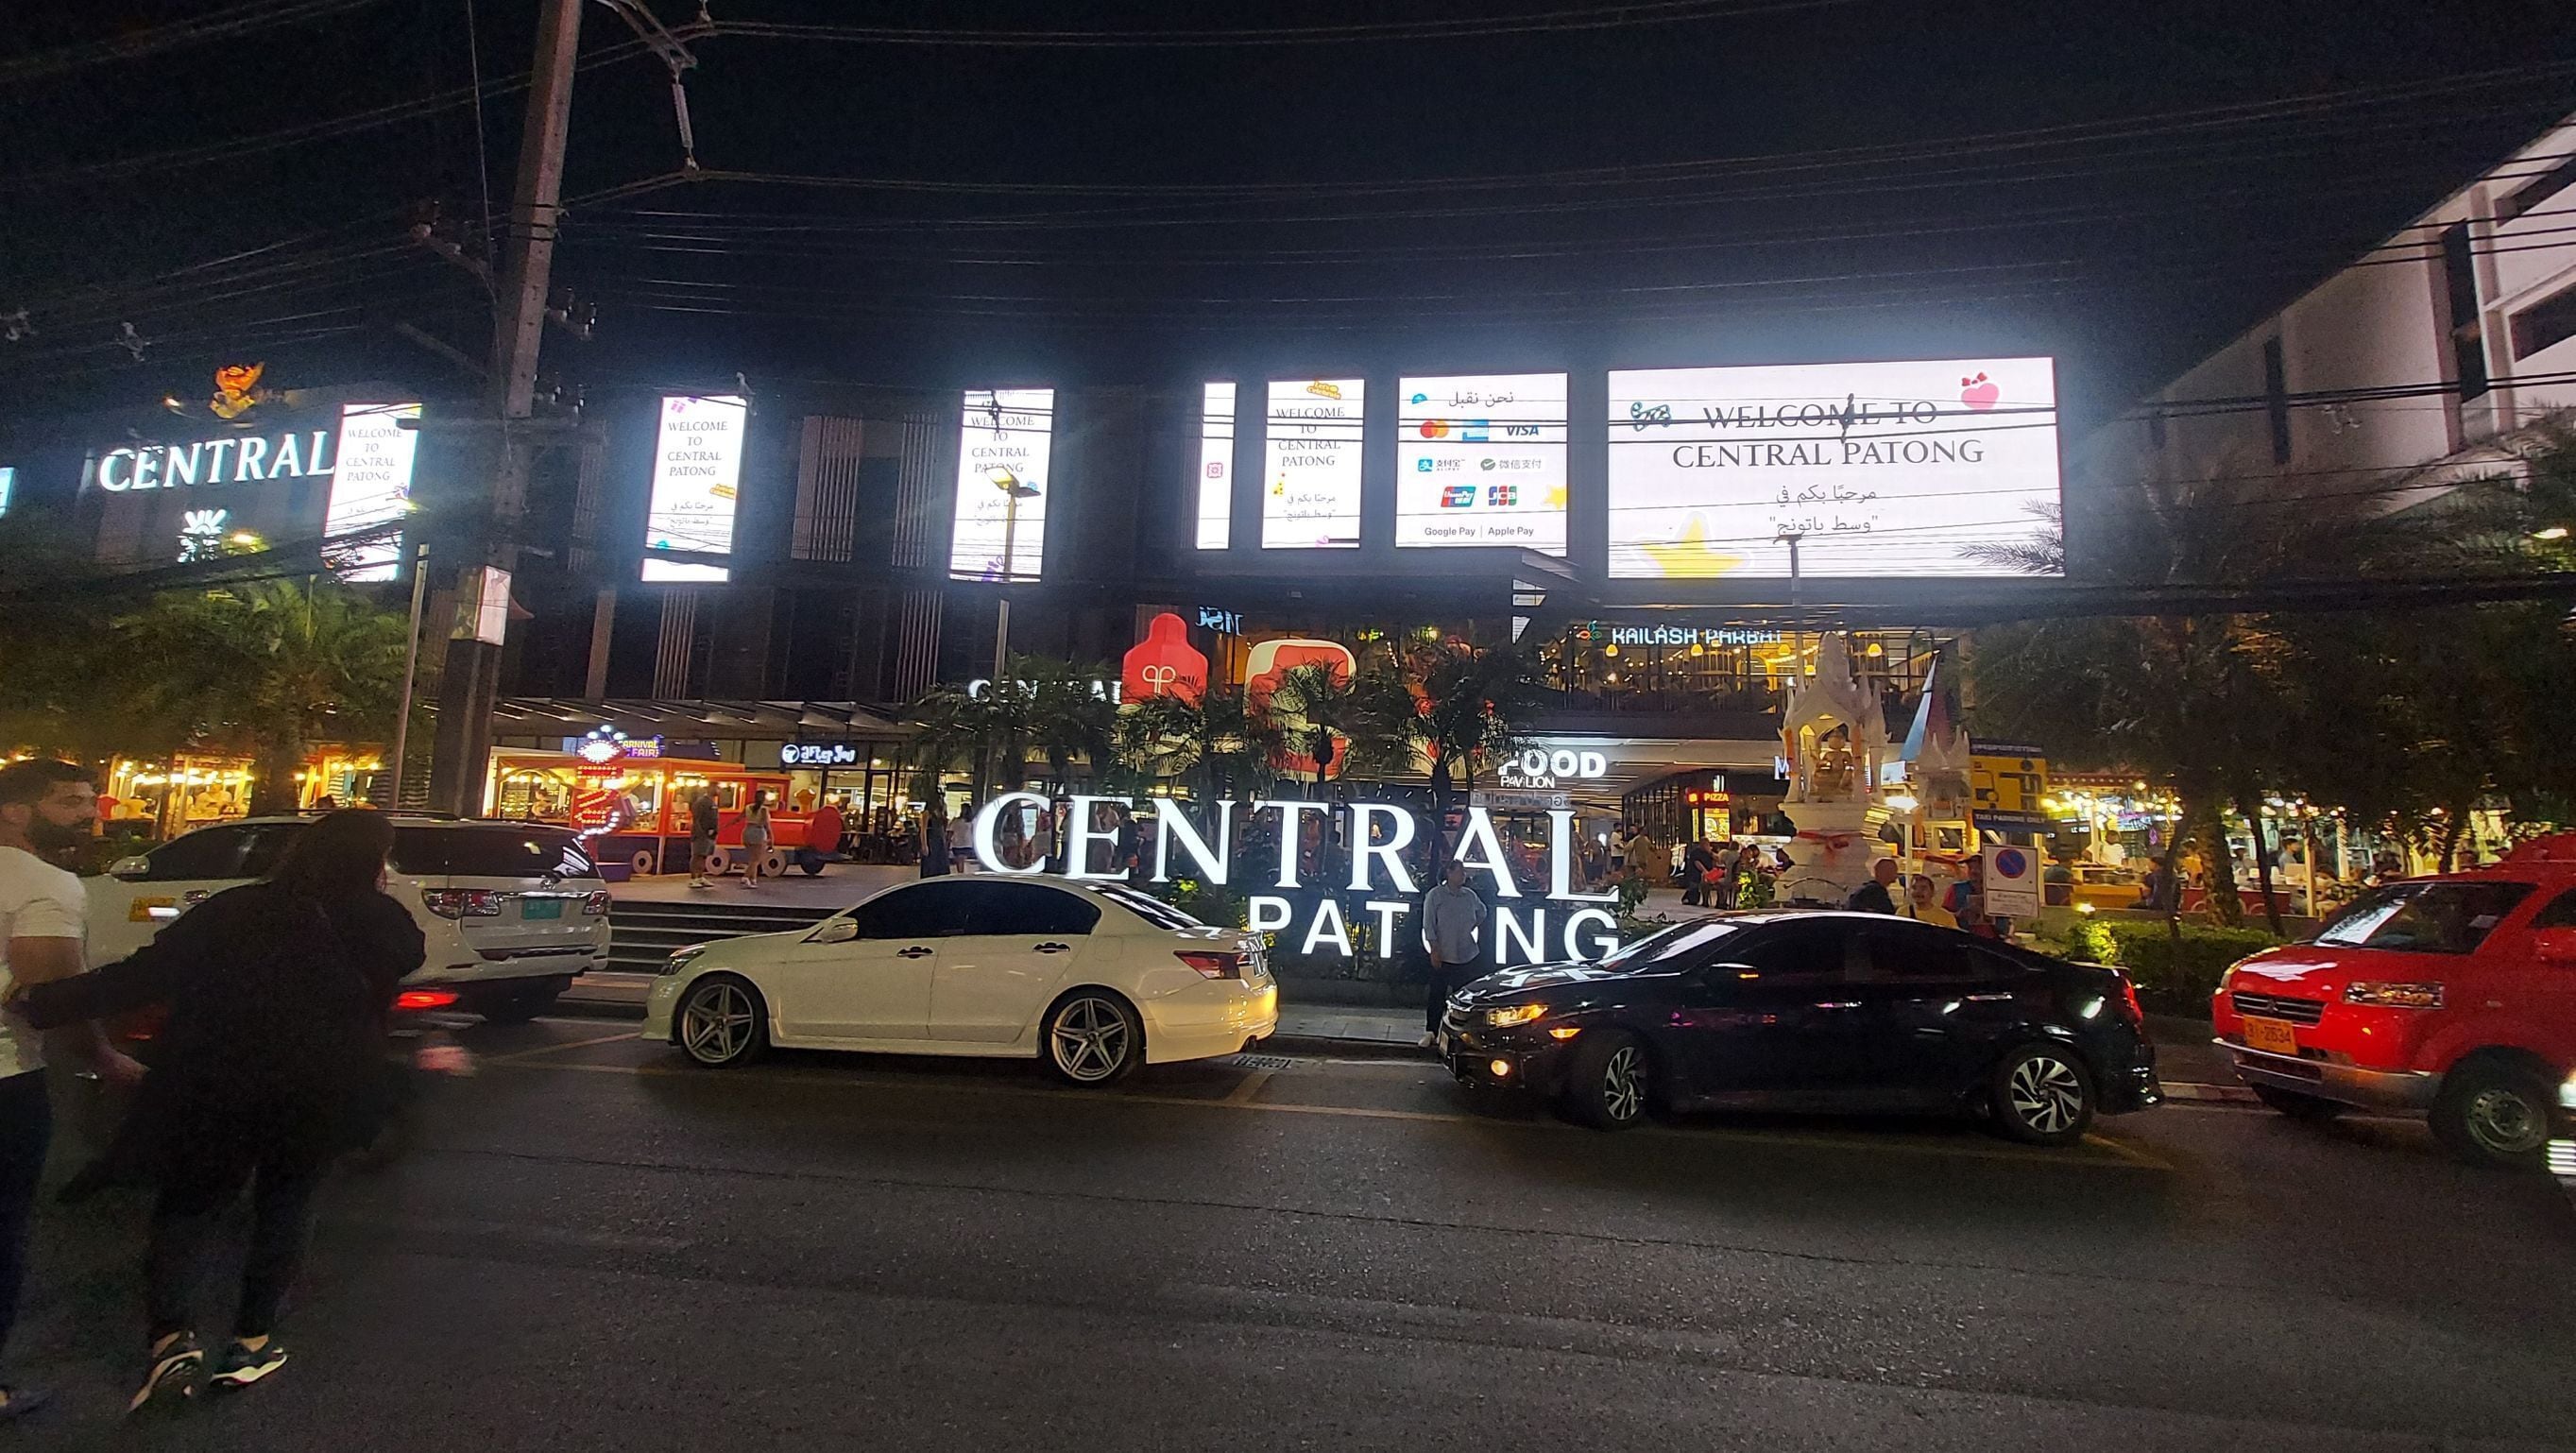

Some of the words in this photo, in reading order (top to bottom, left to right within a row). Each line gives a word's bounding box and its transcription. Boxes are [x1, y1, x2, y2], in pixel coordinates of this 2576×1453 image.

[1276, 406, 1345, 418] WELCOME
[1703, 402, 1881, 429] WELCOME
[1889, 401, 1937, 424] TO
[669, 420, 728, 431] WELCOME
[1506, 425, 1540, 436] VISA
[348, 429, 403, 438] WELCOME
[992, 431, 1008, 441] TO
[688, 436, 702, 446] TO
[1278, 439, 1340, 451] CENTRAL
[365, 443, 379, 453] TO
[971, 447, 1030, 457] CENTRAL
[1673, 442, 1833, 469] CENTRAL
[1842, 438, 1985, 466] PATONG
[99, 431, 335, 492] CENTRAL
[346, 457, 396, 467] CENTRAL
[667, 452, 722, 461] CENTRAL
[1282, 455, 1336, 467] PATONG
[1499, 459, 1542, 470] 微信支付
[347, 471, 390, 481] PATONG
[669, 467, 716, 476] PATONG
[1424, 527, 1457, 537] Google
[1459, 527, 1476, 537] Pay
[1488, 526, 1515, 536] Apple
[1517, 526, 1534, 536] Pay
[1612, 627, 1697, 645] KAILASH
[968, 679, 1122, 705] CNAL
[1500, 776, 1556, 789] PAVILION
[1703, 793, 1730, 802] PIZZA
[973, 792, 1619, 902] CENTRAL
[1248, 895, 1619, 965] PATNG
